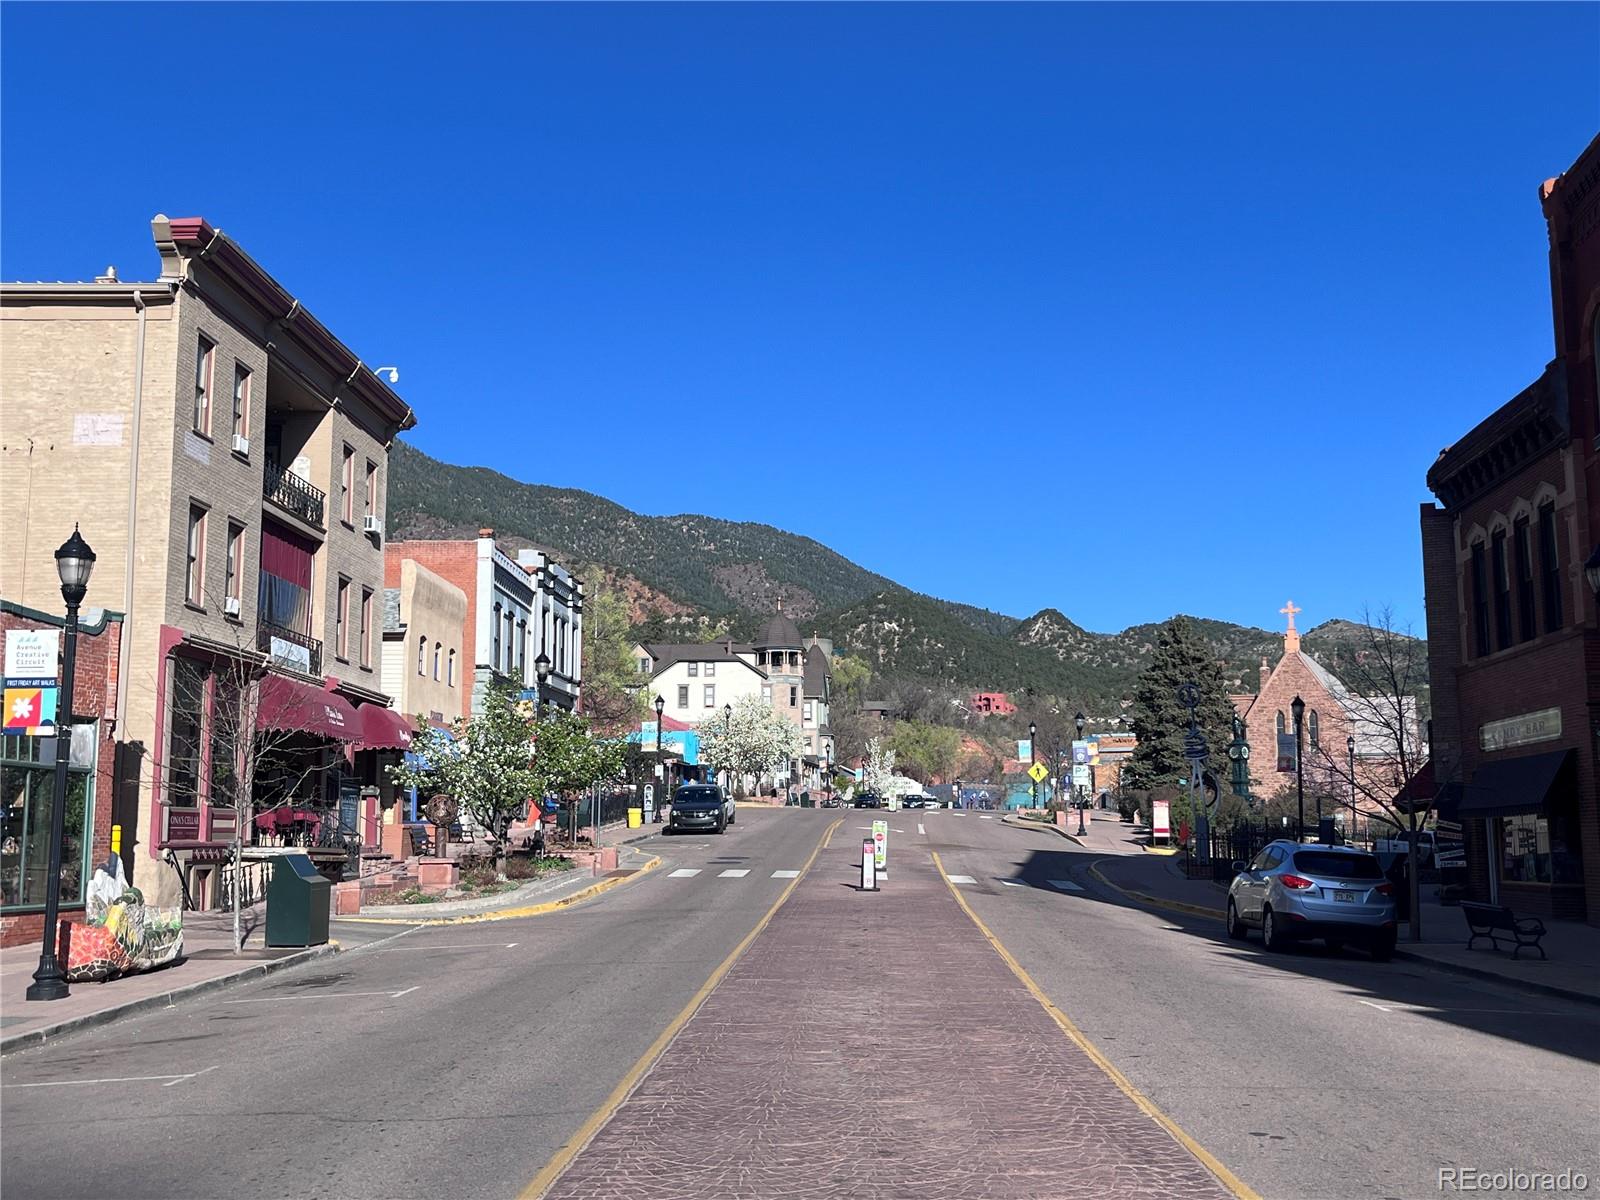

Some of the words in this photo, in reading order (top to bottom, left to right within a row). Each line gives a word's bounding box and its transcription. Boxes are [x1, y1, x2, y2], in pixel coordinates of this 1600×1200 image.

[7, 679, 17, 687] FIRST
[18, 679, 31, 687] FRIDAY
[1526, 720, 1545, 735] BAR
[170, 815, 184, 824] ONA'S
